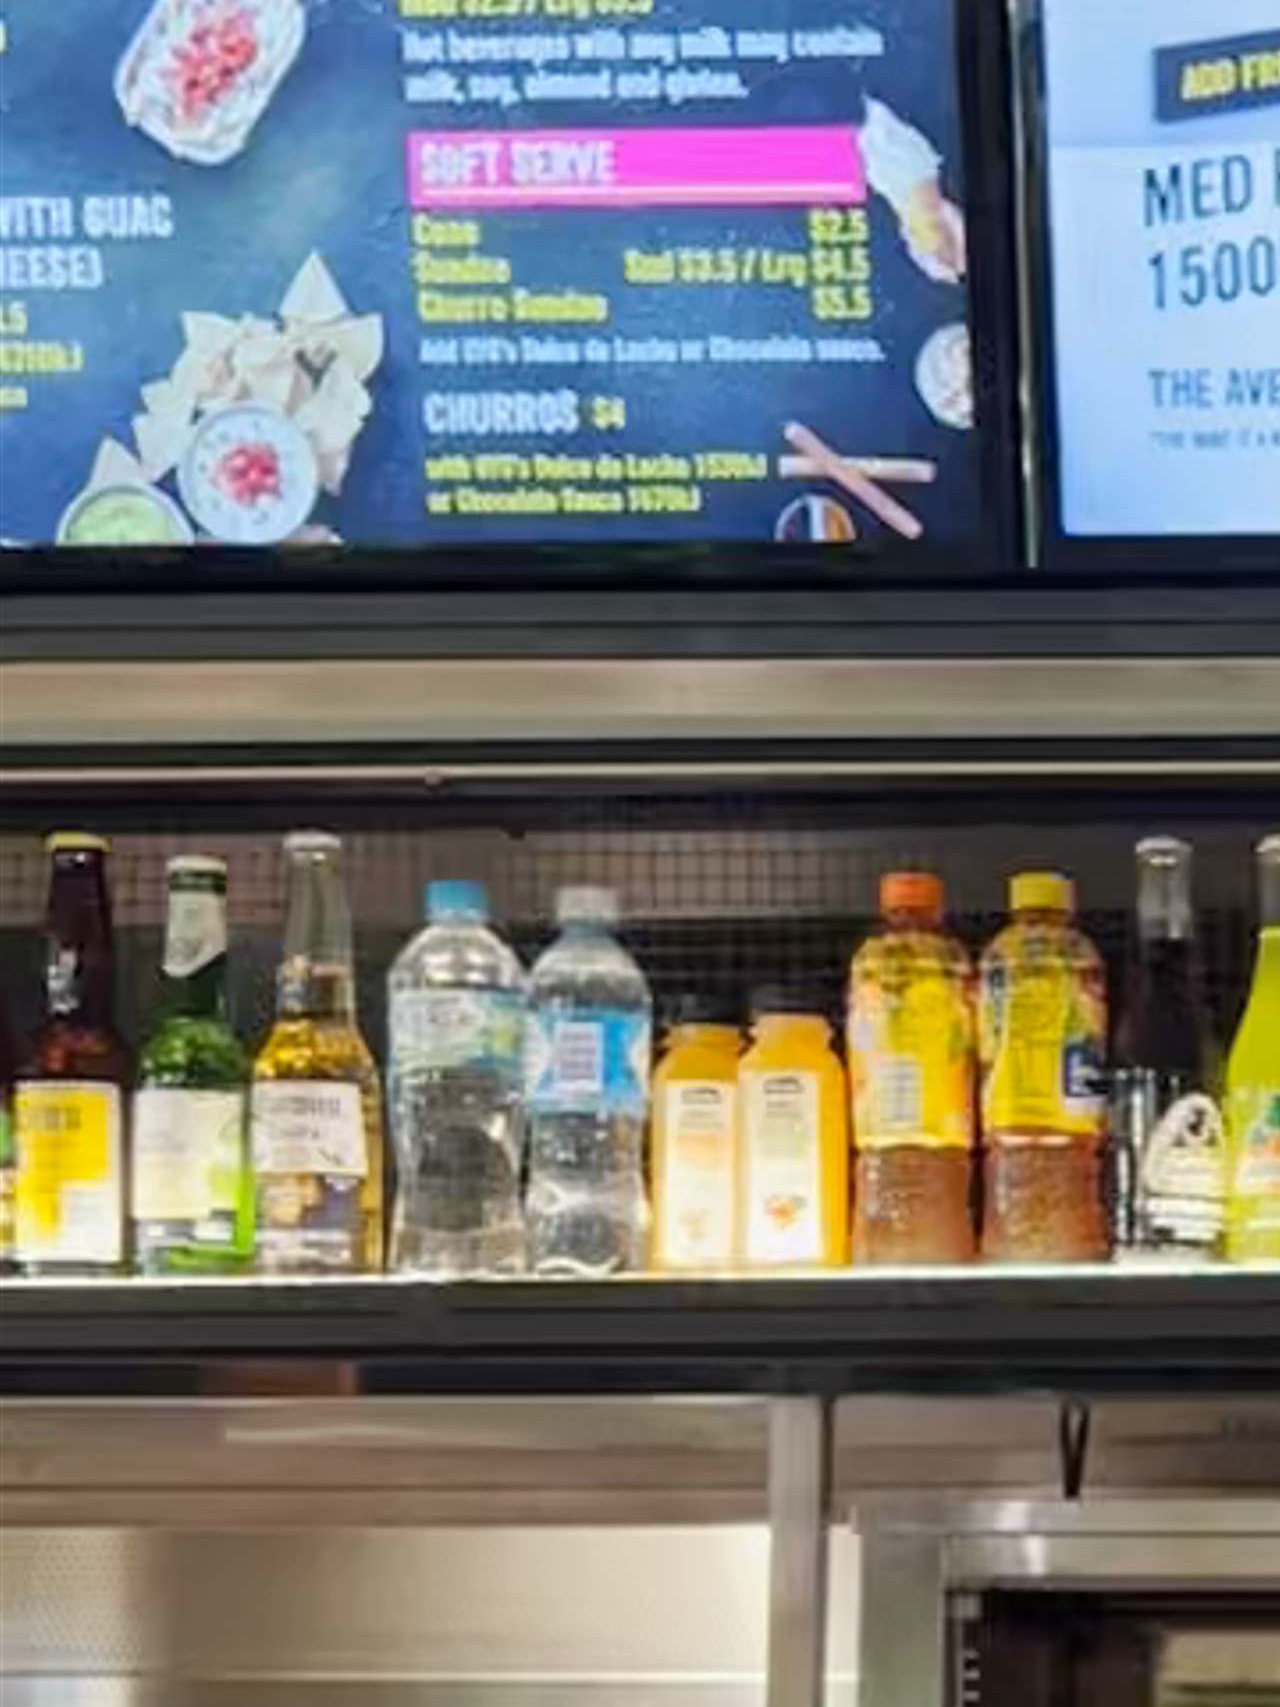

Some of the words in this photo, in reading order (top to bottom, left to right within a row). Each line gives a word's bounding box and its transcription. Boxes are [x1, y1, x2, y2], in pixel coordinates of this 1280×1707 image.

[1182, 58, 1236, 100] ADD
[420, 141, 501, 184] SOFT
[509, 141, 617, 183] SERVE
[1143, 153, 1252, 226] MED
[83, 194, 174, 239] GUAC
[1148, 368, 1213, 408] THE
[425, 391, 579, 433] CHURROS
[591, 397, 625, 427] $4
